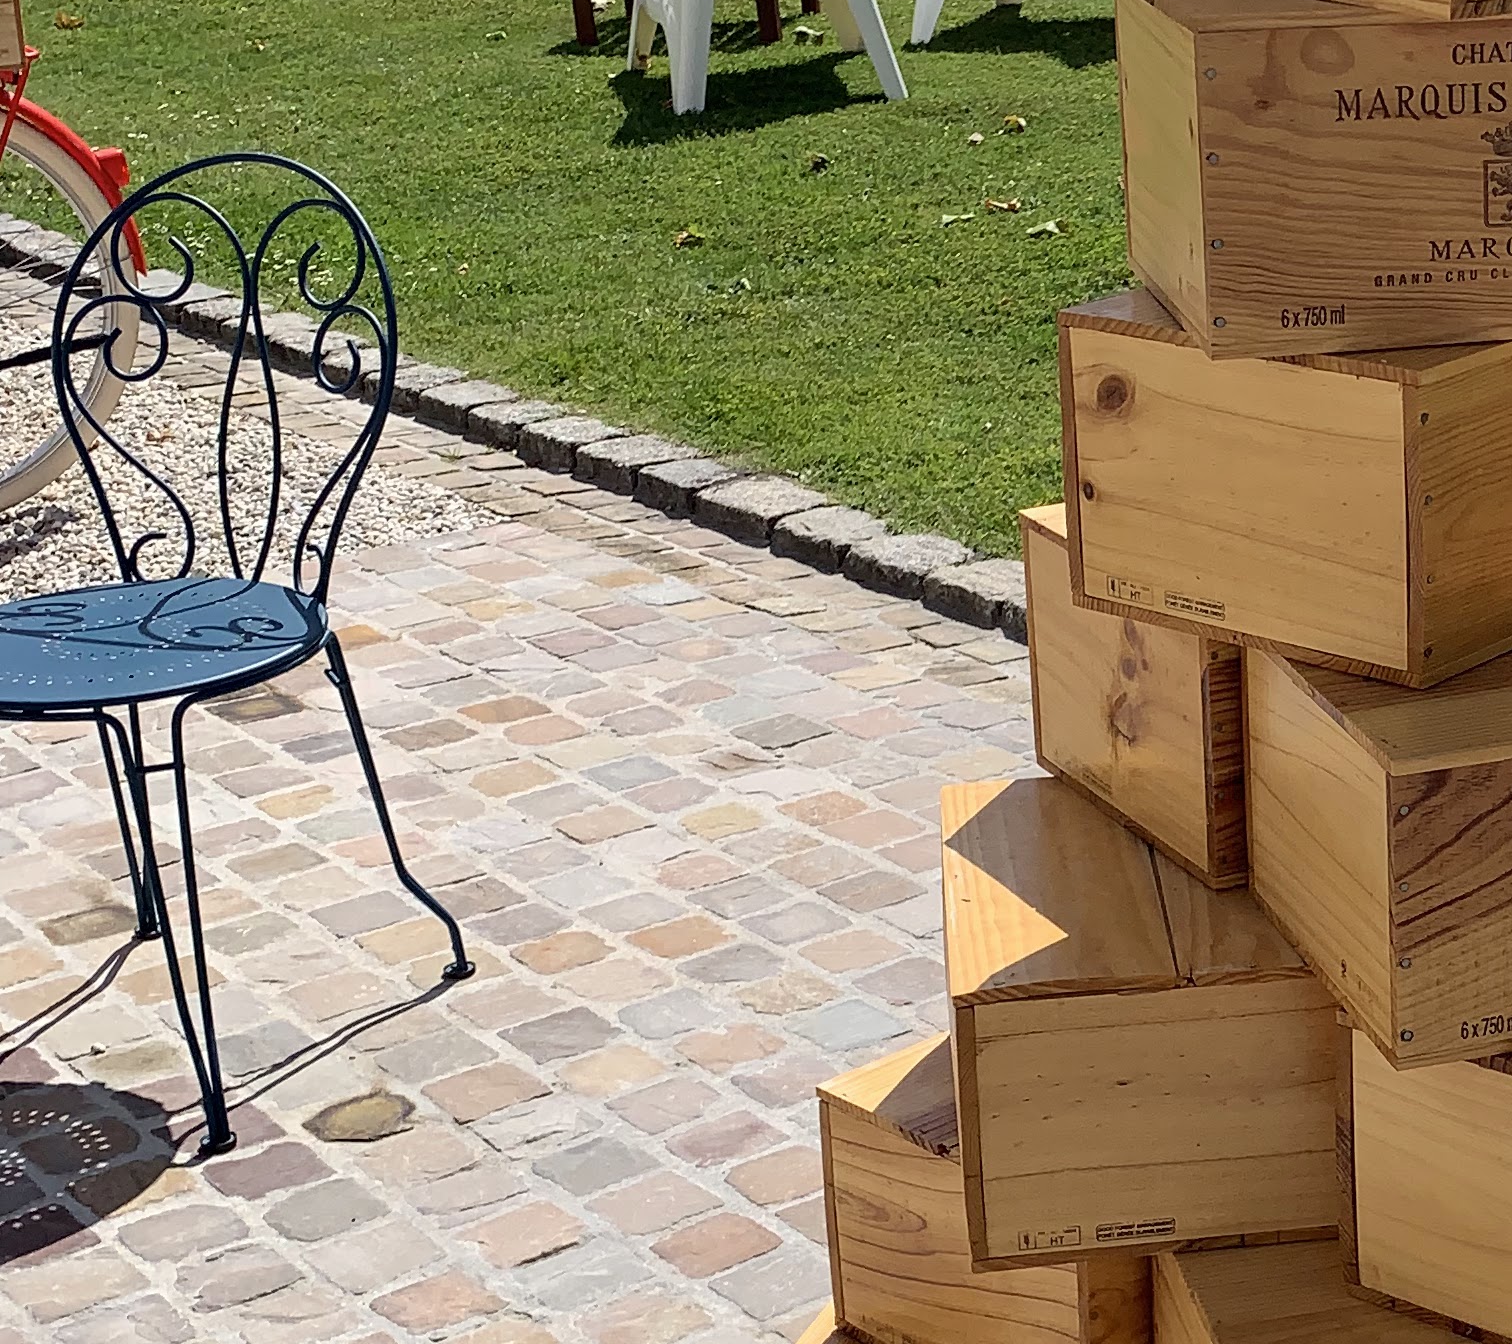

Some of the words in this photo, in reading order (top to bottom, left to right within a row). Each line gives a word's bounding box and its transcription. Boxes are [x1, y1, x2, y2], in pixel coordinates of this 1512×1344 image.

[1334, 81, 1508, 123] MARQUIS
[1373, 272, 1433, 288] GRAND
[1445, 269, 1479, 283] CRU
